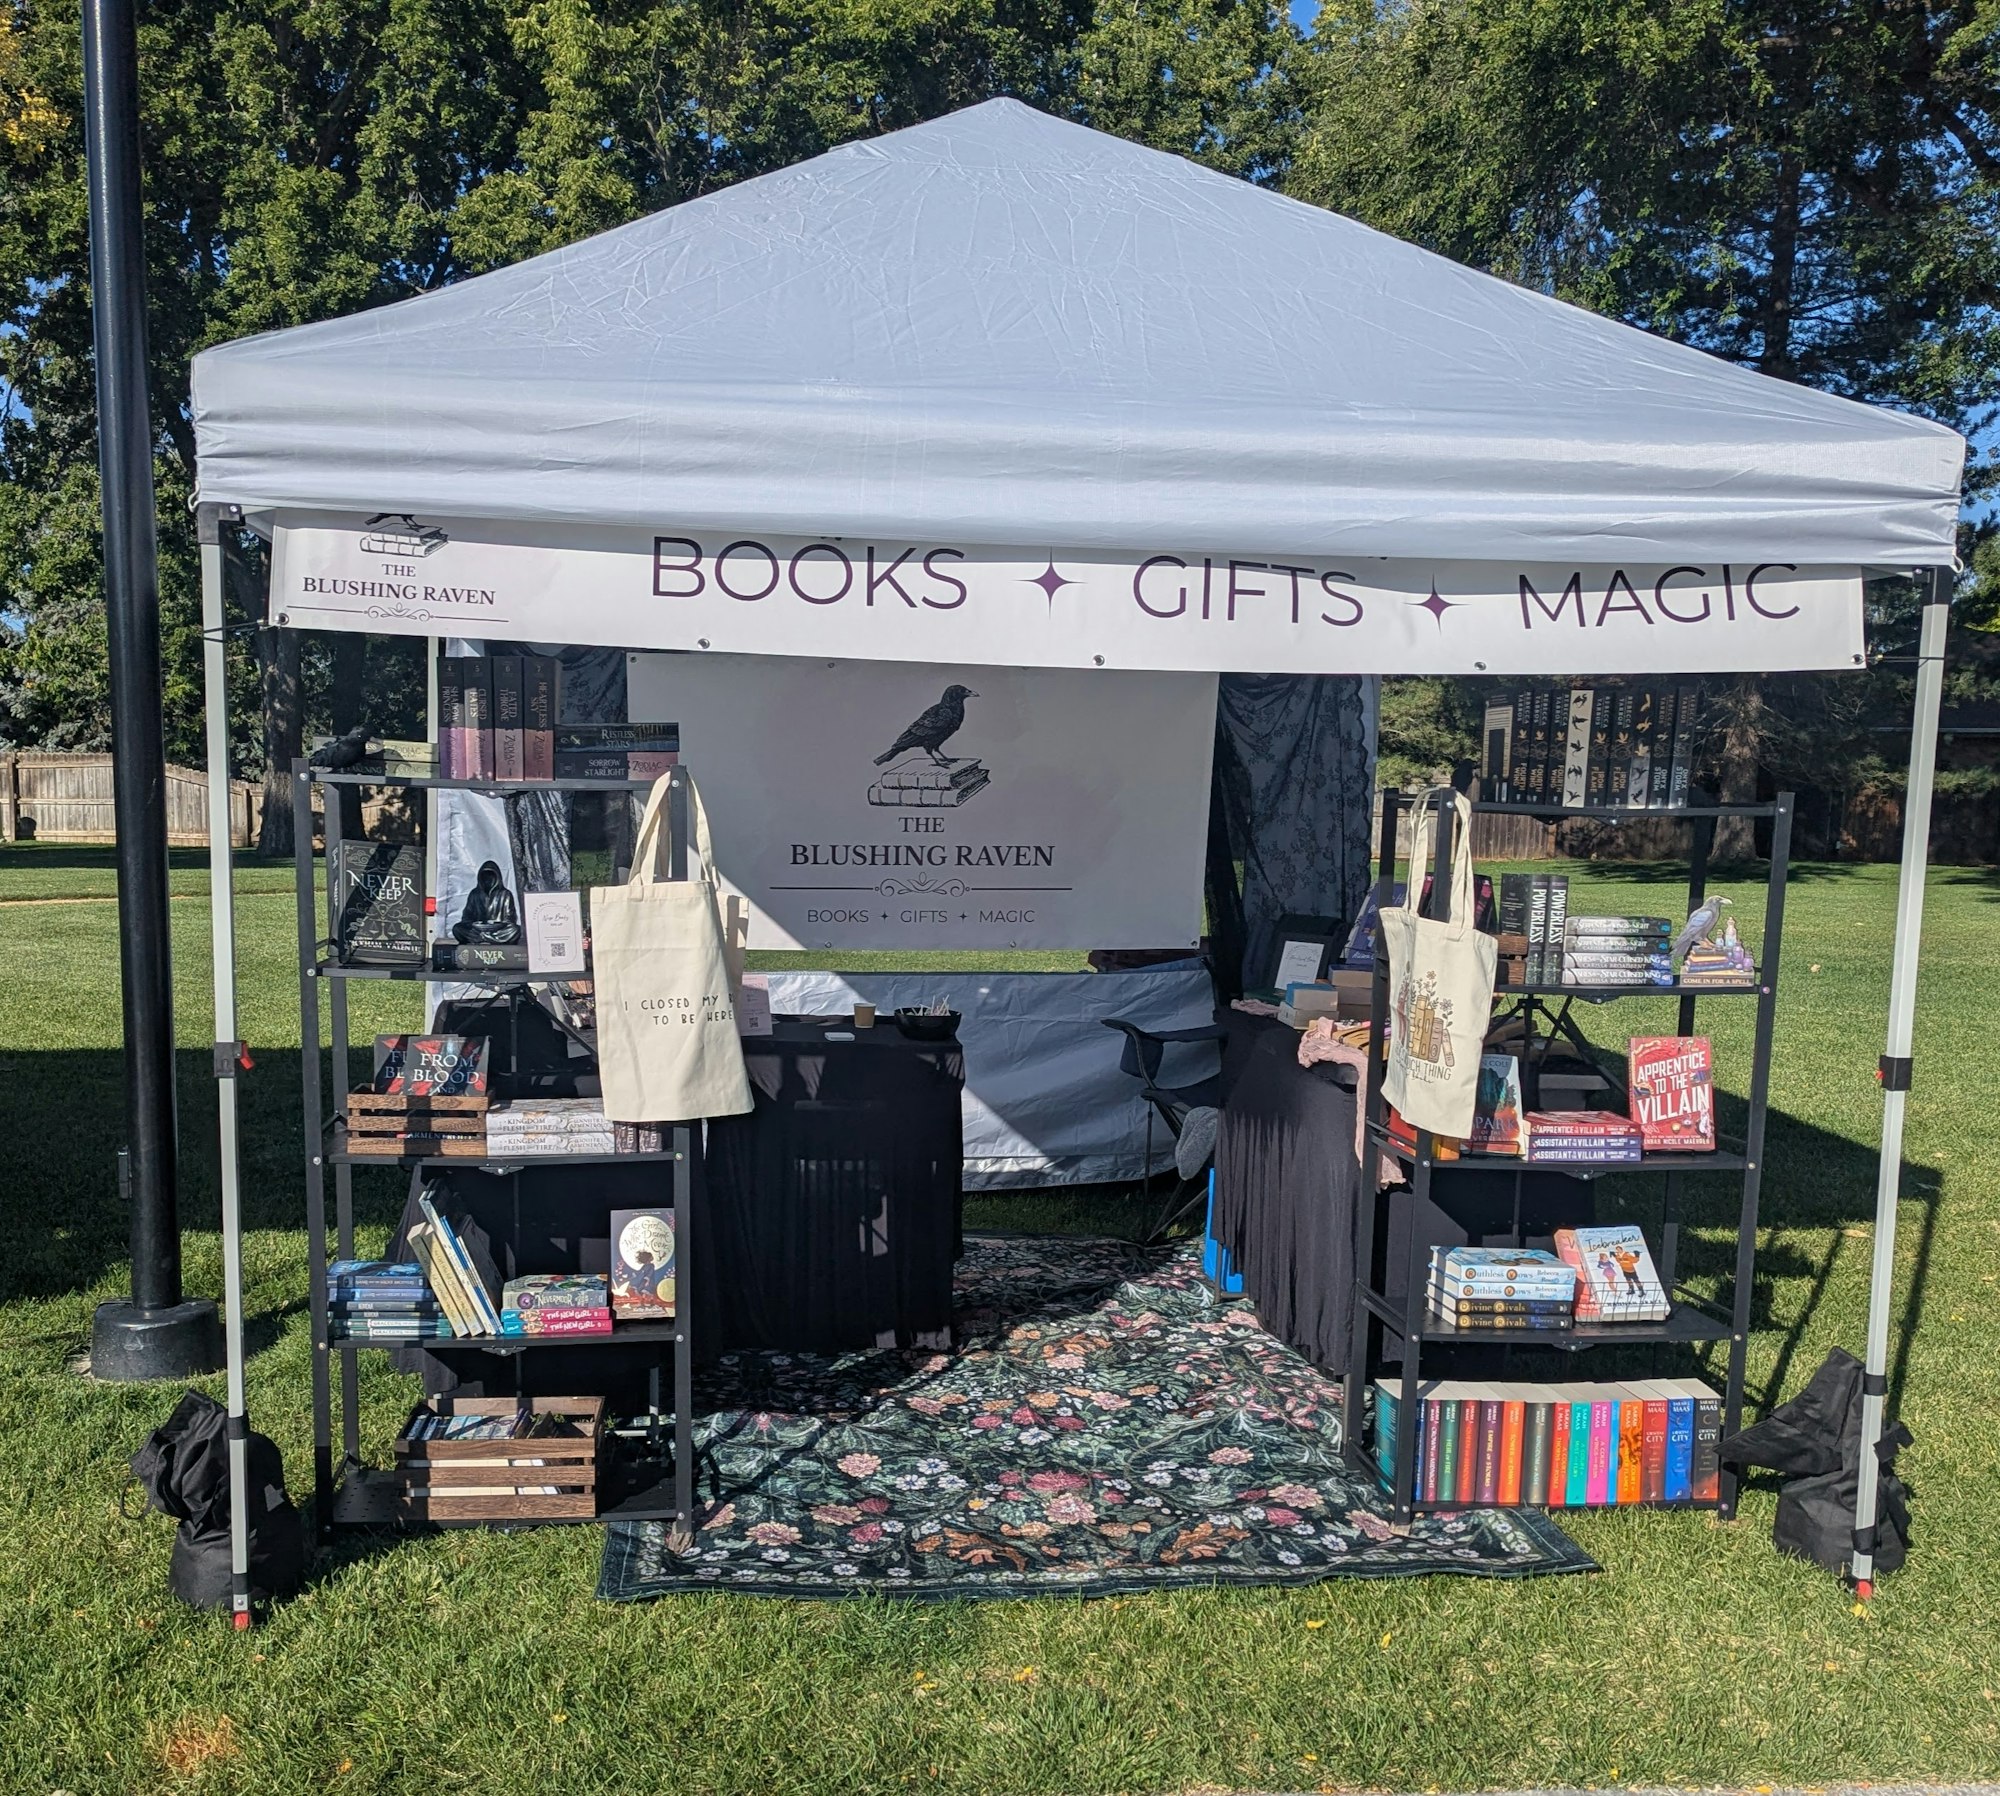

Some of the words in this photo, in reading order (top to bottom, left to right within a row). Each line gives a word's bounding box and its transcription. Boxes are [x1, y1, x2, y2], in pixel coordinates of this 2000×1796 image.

[381, 563, 416, 578] THE
[652, 536, 967, 611] BOOKS
[1133, 555, 1363, 627] GIFTS
[1517, 564, 1800, 629] MAGIC
[302, 576, 418, 601] BLUSHING
[423, 586, 496, 606] RAVEN
[584, 768, 626, 777] STARLIGHT
[1653, 766, 1662, 791] STORM
[1674, 766, 1683, 791] STORM
[898, 817, 945, 833] THE
[790, 844, 948, 867] BLUSHING
[954, 844, 1055, 867] RAVEN
[346, 869, 419, 895] NEVER
[369, 888, 402, 901] KEEP
[807, 910, 869, 923] BOOKS
[900, 910, 948, 923] GIFTS
[979, 910, 1035, 923] MAGIC
[1529, 888, 1547, 943] POWERLESS
[1548, 889, 1567, 944] POWERLESS
[474, 949, 506, 961] NEVER
[624, 1001, 628, 1011] I
[641, 998, 690, 1010] CLOSED
[702, 995, 719, 1007] MY
[653, 1015, 669, 1025] TO
[681, 1014, 695, 1024] BE
[707, 1010, 733, 1022] HERE
[420, 1053, 474, 1067] FROM
[1637, 1051, 1706, 1083] APPRENTICE
[413, 1068, 480, 1084] BLOOD
[1424, 1063, 1452, 1081] THING
[1654, 1077, 1666, 1094] TO
[1670, 1073, 1689, 1091] THE
[1637, 1084, 1710, 1124] VILLAIN
[1538, 1125, 1574, 1134] APPRENTICE
[1580, 1126, 1605, 1134] VILLAIN
[1537, 1138, 1572, 1147] ASSISTANT
[1577, 1138, 1605, 1147] VILLAIN
[1536, 1151, 1572, 1160] ASSISTANT
[1577, 1151, 1605, 1159] VILLAIN
[1585, 1232, 1640, 1252] Icebreaker
[1465, 1268, 1504, 1279] Ruthless
[1506, 1269, 1533, 1280] Vows
[1463, 1285, 1502, 1296] Ruthless
[1504, 1286, 1531, 1297] Vows
[1460, 1301, 1492, 1312] Divine
[1494, 1301, 1526, 1312] Rivals
[546, 1311, 560, 1320] THE
[560, 1310, 575, 1319] NEW
[575, 1310, 592, 1319] GIRL
[1460, 1315, 1492, 1327] Divine
[1495, 1316, 1526, 1327] Rivals
[550, 1323, 564, 1331] THE
[563, 1321, 578, 1331] NEW
[578, 1321, 595, 1330] GIRL
